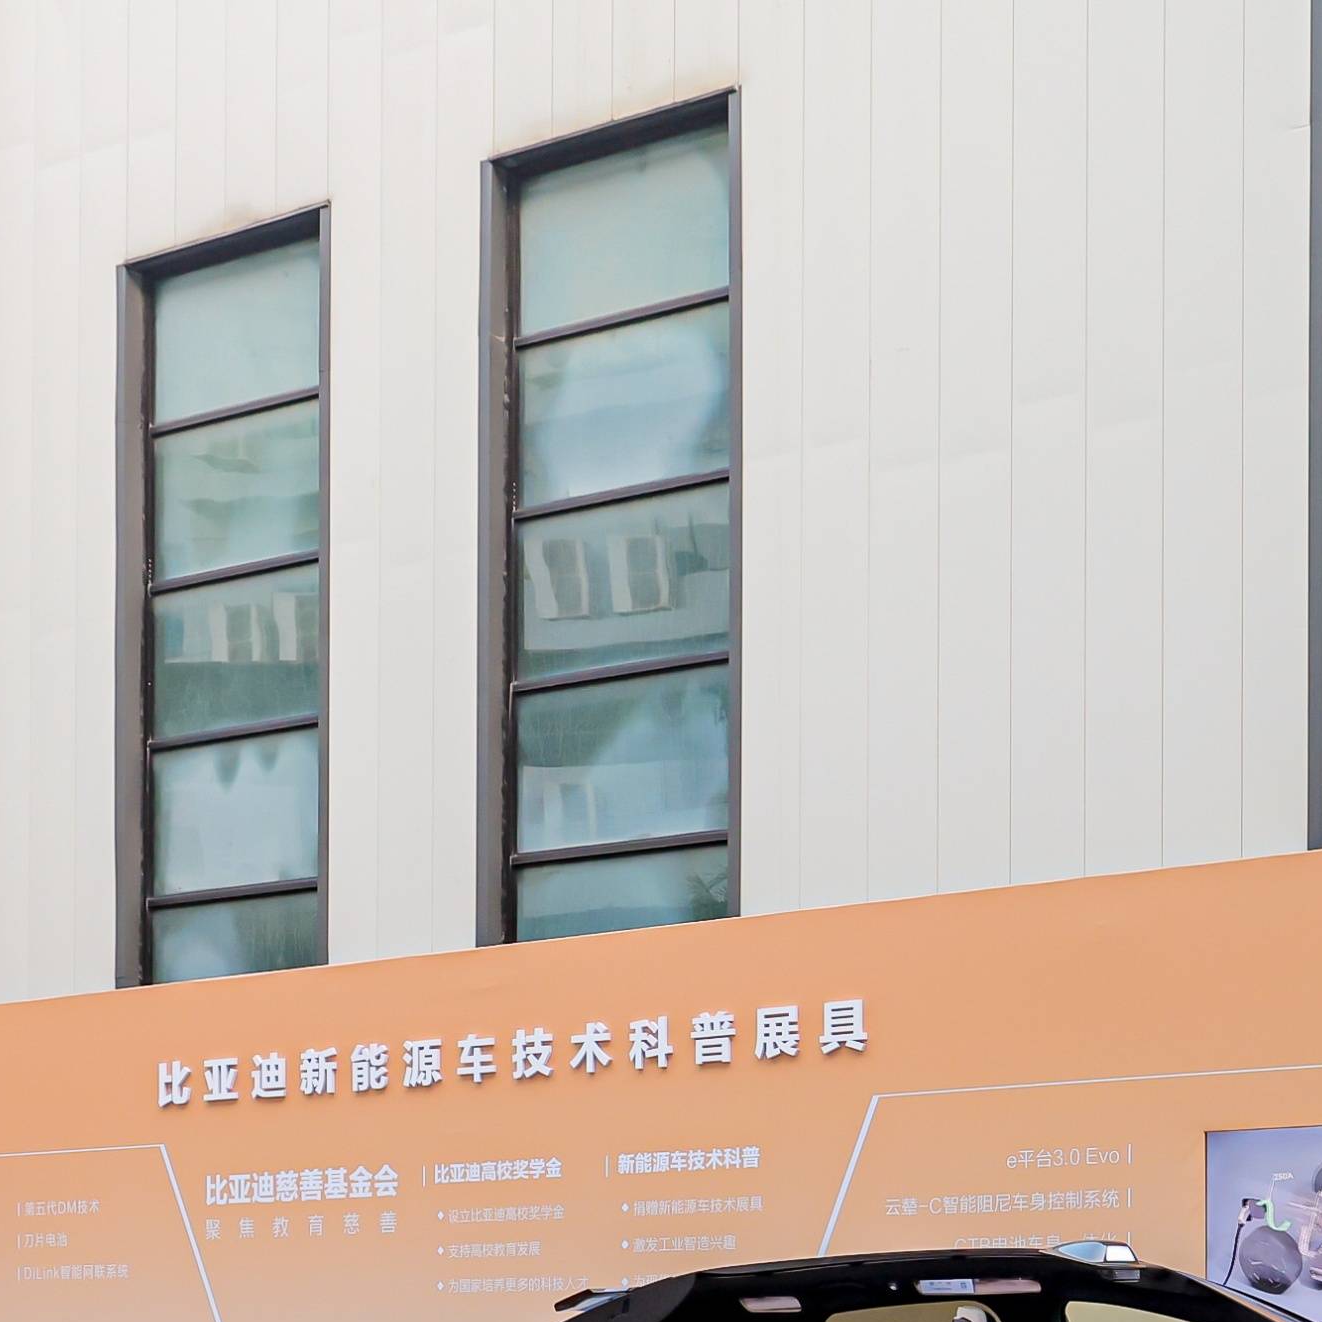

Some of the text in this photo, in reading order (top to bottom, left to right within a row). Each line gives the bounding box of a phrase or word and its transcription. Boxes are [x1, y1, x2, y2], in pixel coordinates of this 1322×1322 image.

[156, 998, 869, 1108] 比亚迪新能源车技术科普展具
[433, 1158, 563, 1185] 比亚迪高校奖学金
[617, 1146, 761, 1175] 新能源车技术科普
[1006, 1147, 1120, 1169] e平台3.0 Evo
[205, 1163, 399, 1206] 比亚迪慈善基金会
[205, 1210, 398, 1241] 聚焦教育慈善
